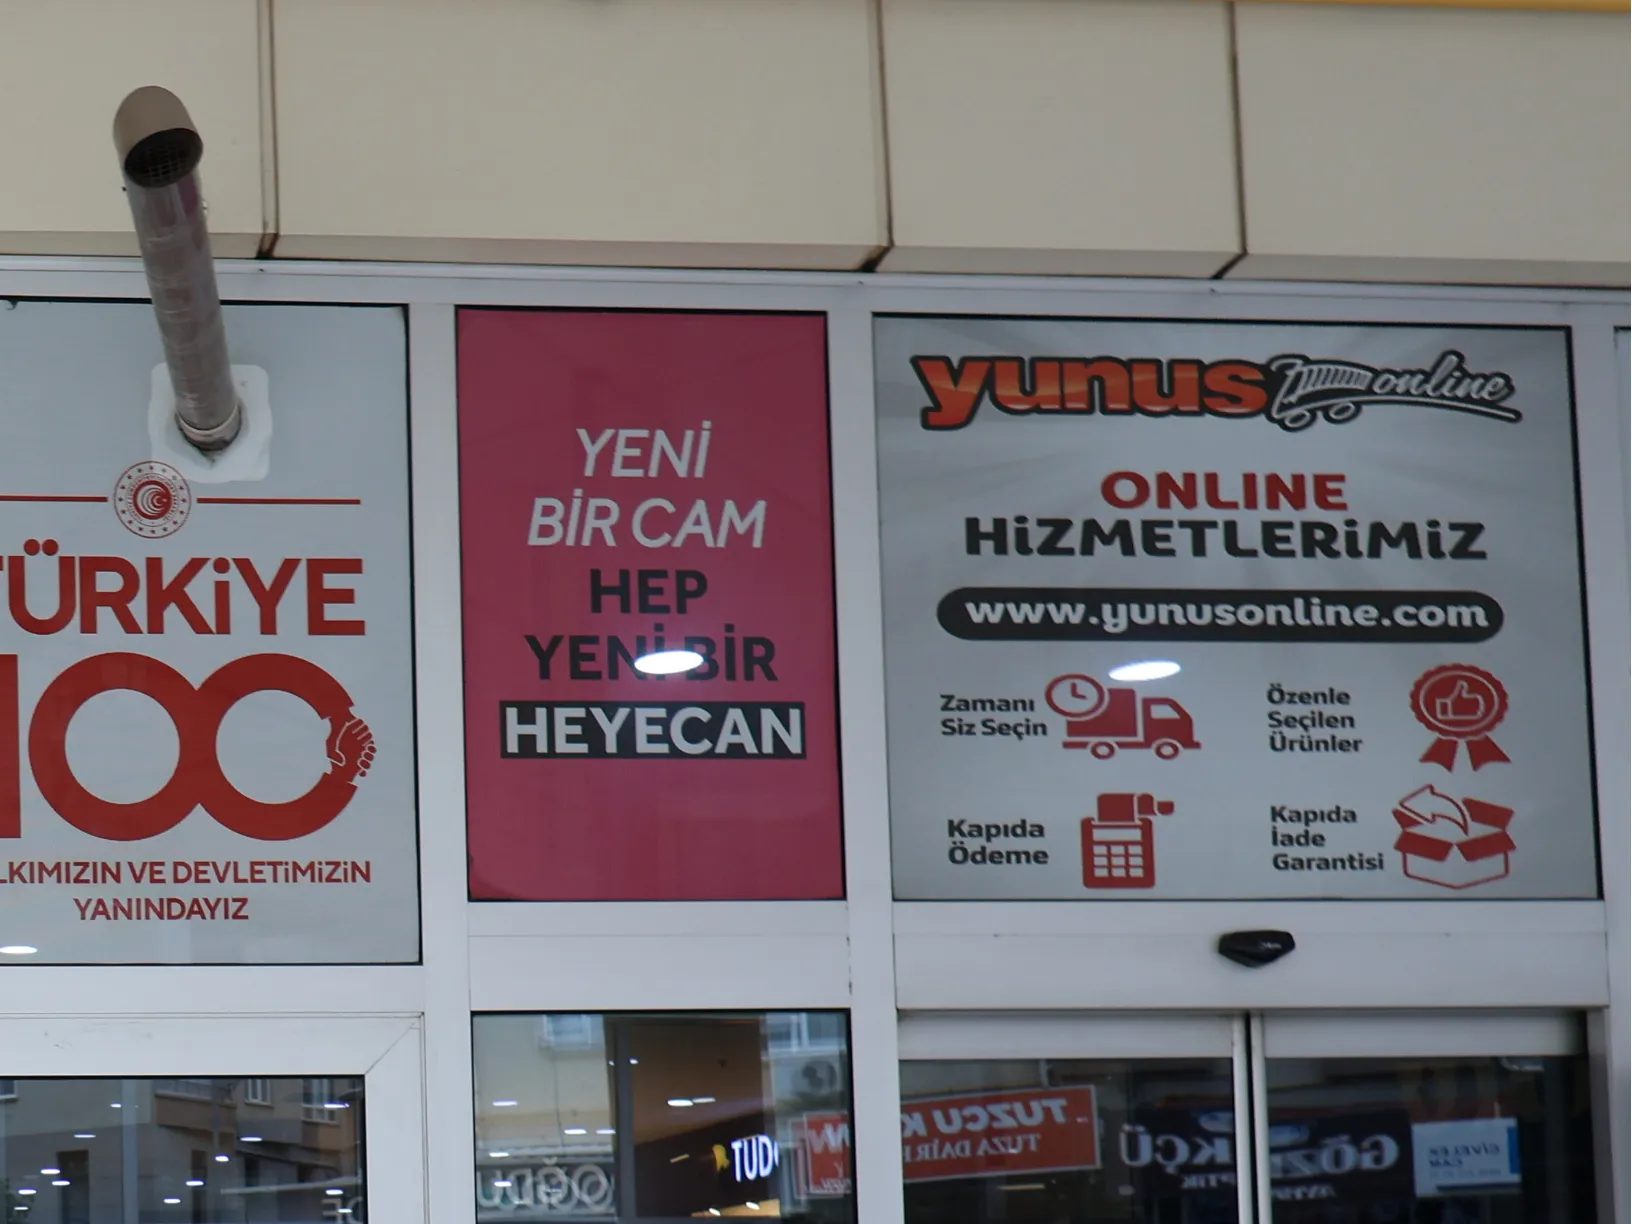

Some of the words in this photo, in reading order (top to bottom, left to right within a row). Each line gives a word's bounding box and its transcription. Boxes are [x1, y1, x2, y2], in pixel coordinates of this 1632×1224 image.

[910, 355, 1269, 431] yunus
[1371, 350, 1515, 403] online
[576, 420, 712, 478] YENİ
[1100, 471, 1349, 511] ONLINE
[527, 488, 620, 546] BİR
[631, 498, 766, 548] CAM
[590, 568, 708, 614] HEP
[965, 598, 1488, 634] www.yunusonline.com
[683, 623, 779, 682] BİR
[940, 694, 1035, 712] Zamanı
[1267, 683, 1351, 705] Özenle
[504, 706, 803, 755] HEYECAN
[941, 718, 976, 736] Siz
[981, 718, 1048, 740] Seçin
[1267, 710, 1356, 732] Seçilen
[1269, 730, 1363, 752] Ürünler
[1270, 805, 1357, 827] Kapıda
[947, 818, 1045, 843] Kapıda
[1271, 826, 1326, 848] İade
[948, 841, 1049, 865] Ödeme
[1272, 852, 1385, 871] Garantisi
[128, 861, 166, 885] VE
[73, 897, 249, 921] YANINDAYIZ
[731, 1134, 779, 1182] TUD
